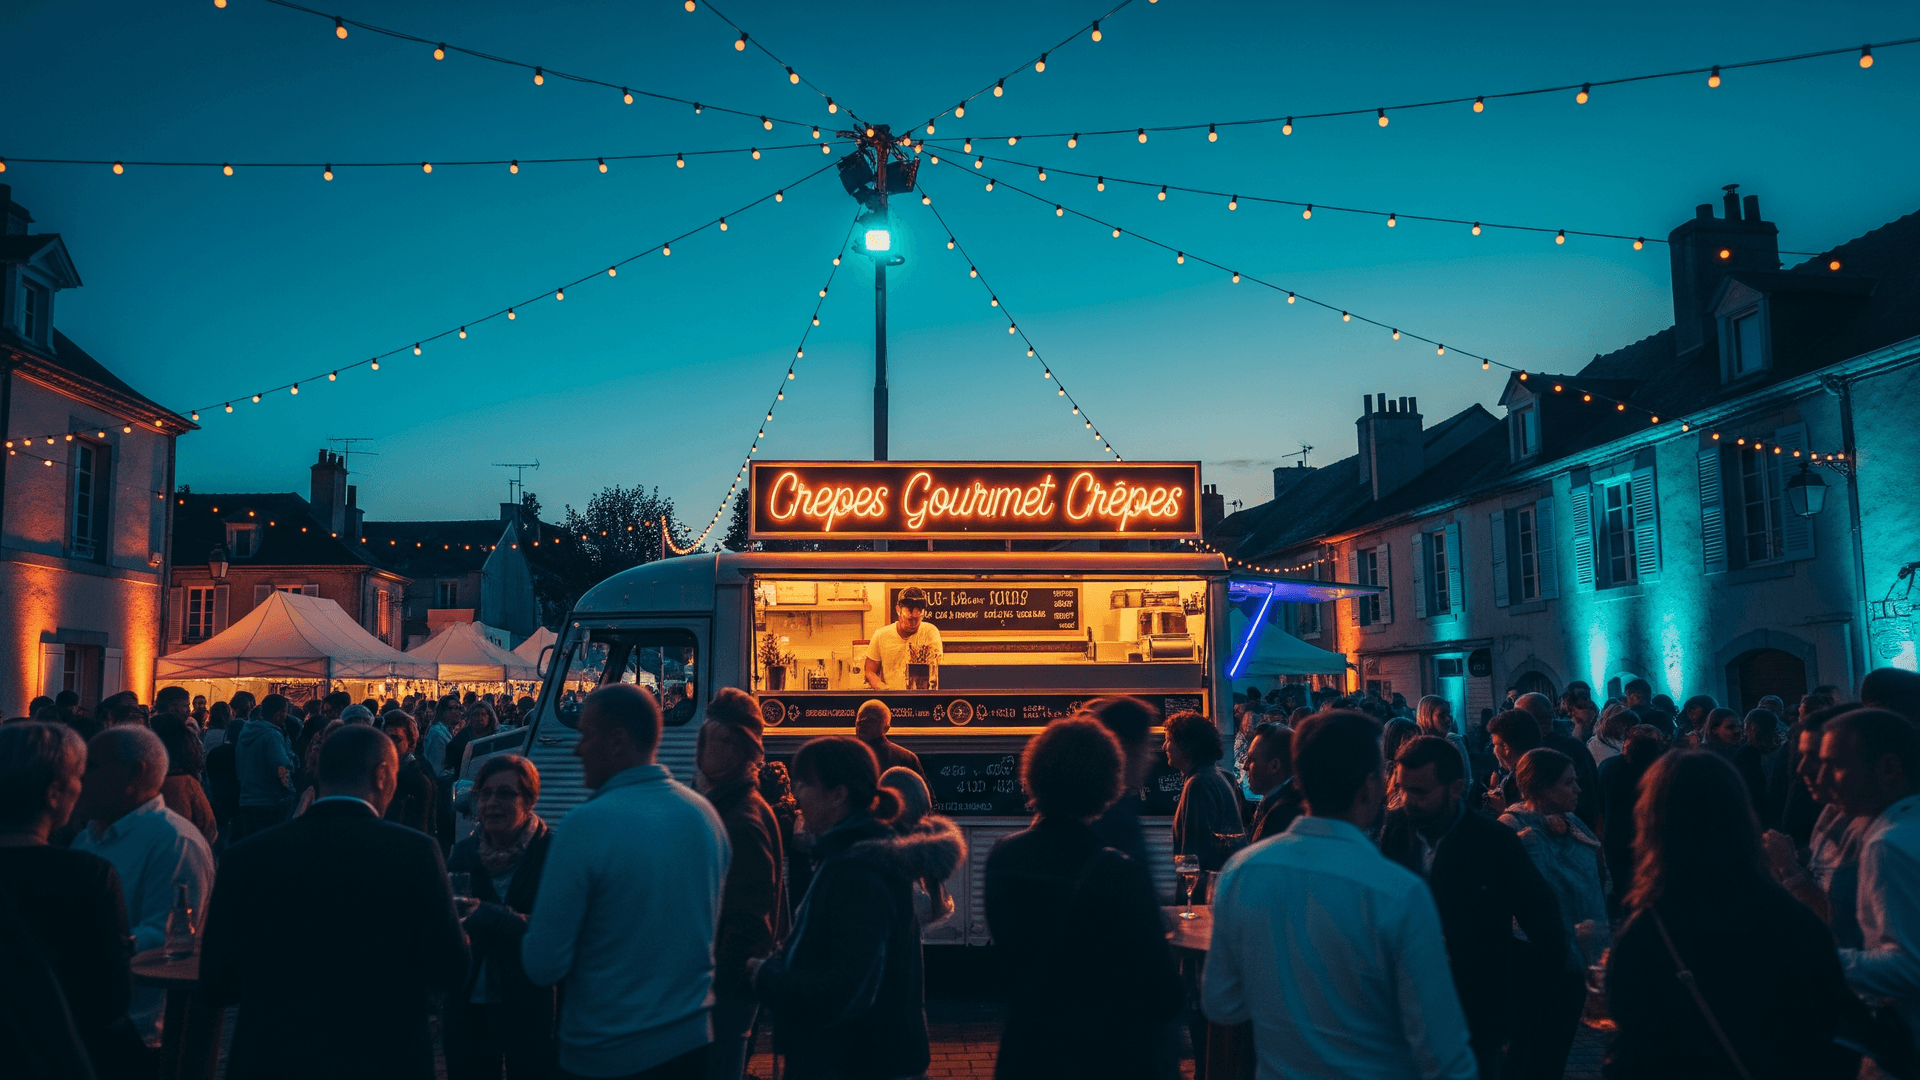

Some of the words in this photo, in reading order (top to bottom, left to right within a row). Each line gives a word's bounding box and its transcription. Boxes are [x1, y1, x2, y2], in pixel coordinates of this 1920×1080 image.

[770, 472, 888, 531] Crepes
[903, 472, 1056, 529] Gourmet
[1066, 472, 1183, 531] Crêpes
